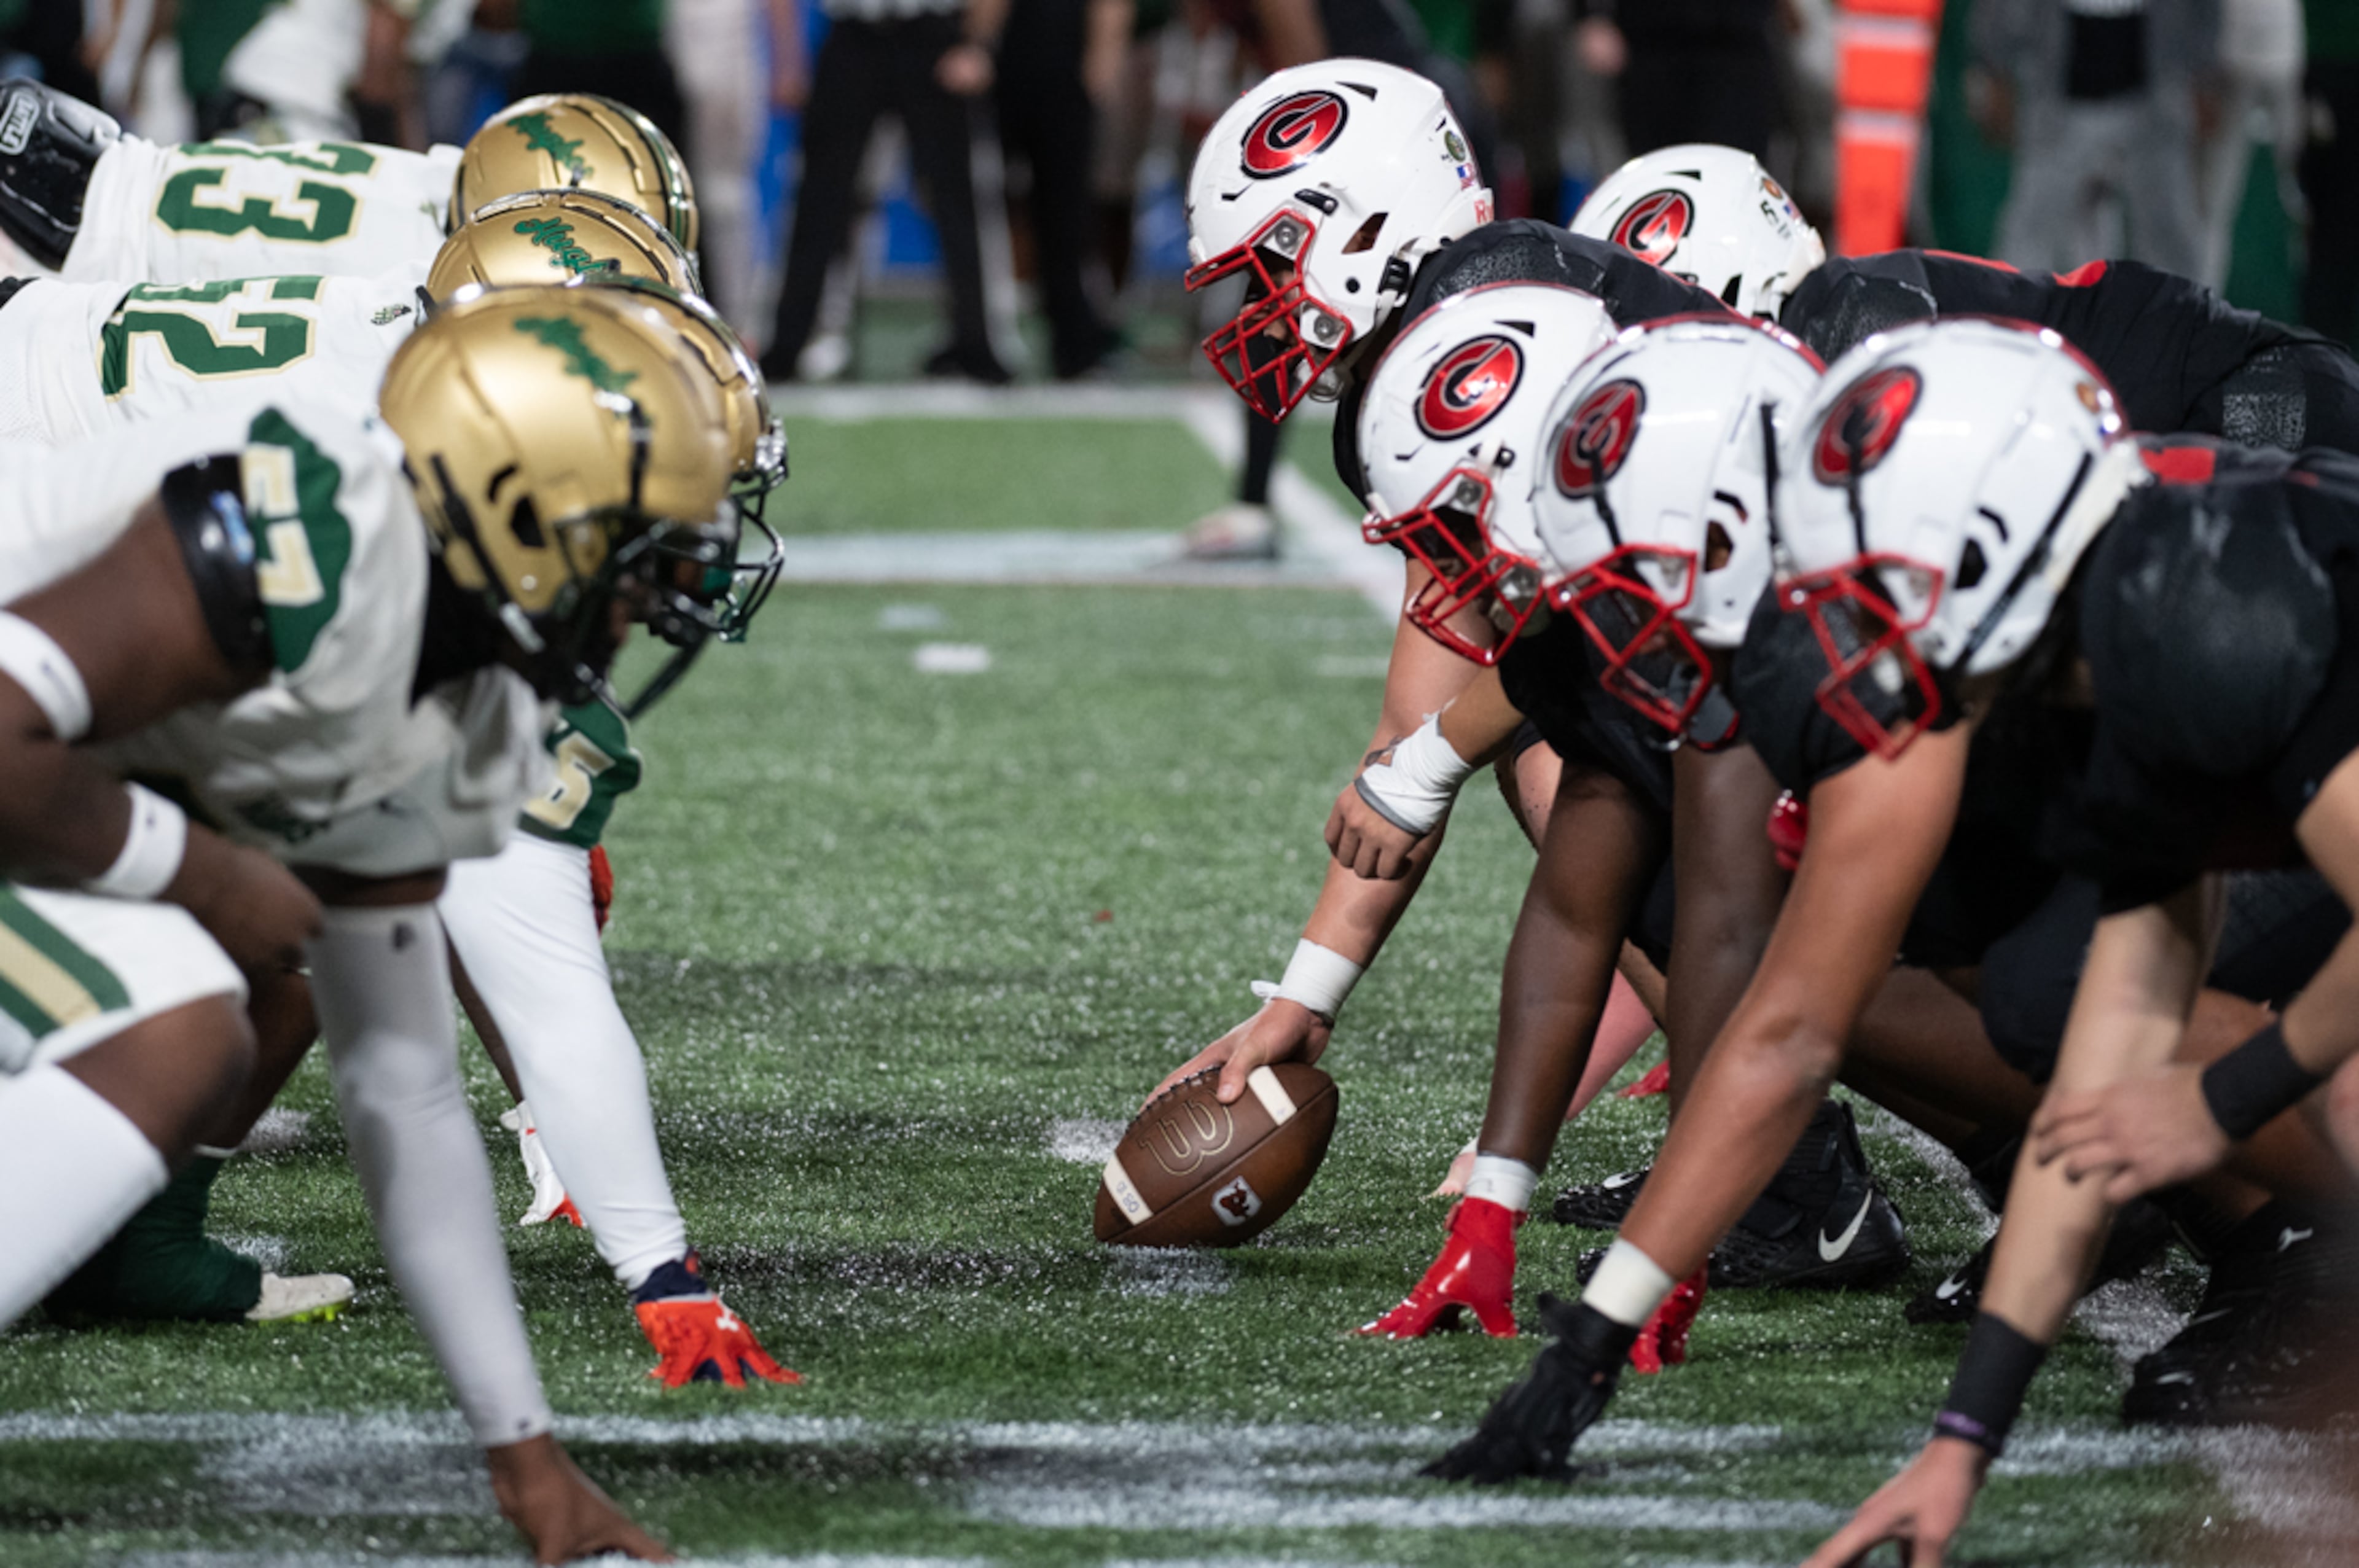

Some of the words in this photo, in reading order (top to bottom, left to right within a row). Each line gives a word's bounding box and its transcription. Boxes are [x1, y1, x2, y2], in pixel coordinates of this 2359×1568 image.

[1242, 91, 1348, 178] G
[1610, 189, 1694, 265] G
[1414, 334, 1524, 442] G
[1555, 378, 1646, 499] G
